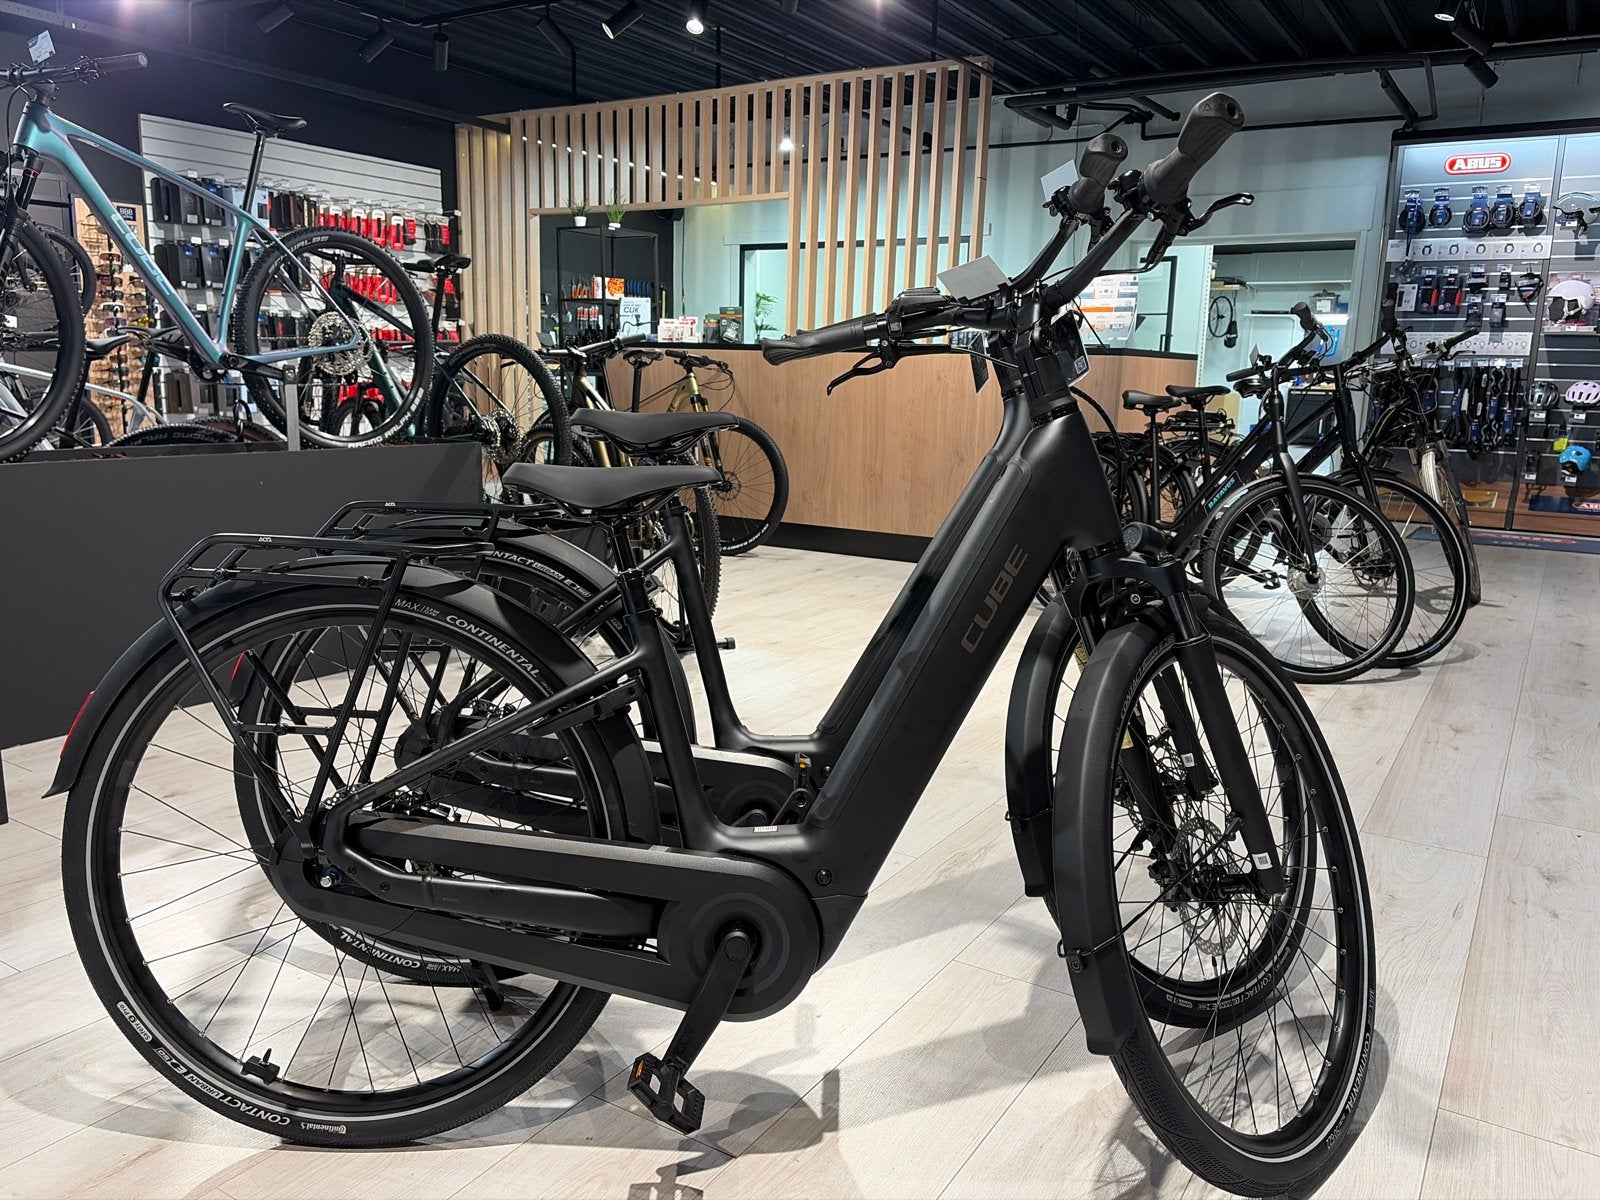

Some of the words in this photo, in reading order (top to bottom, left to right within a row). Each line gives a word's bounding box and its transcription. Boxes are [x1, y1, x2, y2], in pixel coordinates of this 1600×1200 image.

[1453, 157, 1502, 170] ABUS
[384, 411, 412, 438] RALPH
[960, 543, 1028, 653] CUBE
[445, 614, 541, 678] CONTINENTAL
[133, 1018, 151, 1041] Safety
[187, 1073, 223, 1099] URBAN
[1346, 1032, 1371, 1113] CONTINENTAL
[219, 1094, 291, 1126] CONTACT
